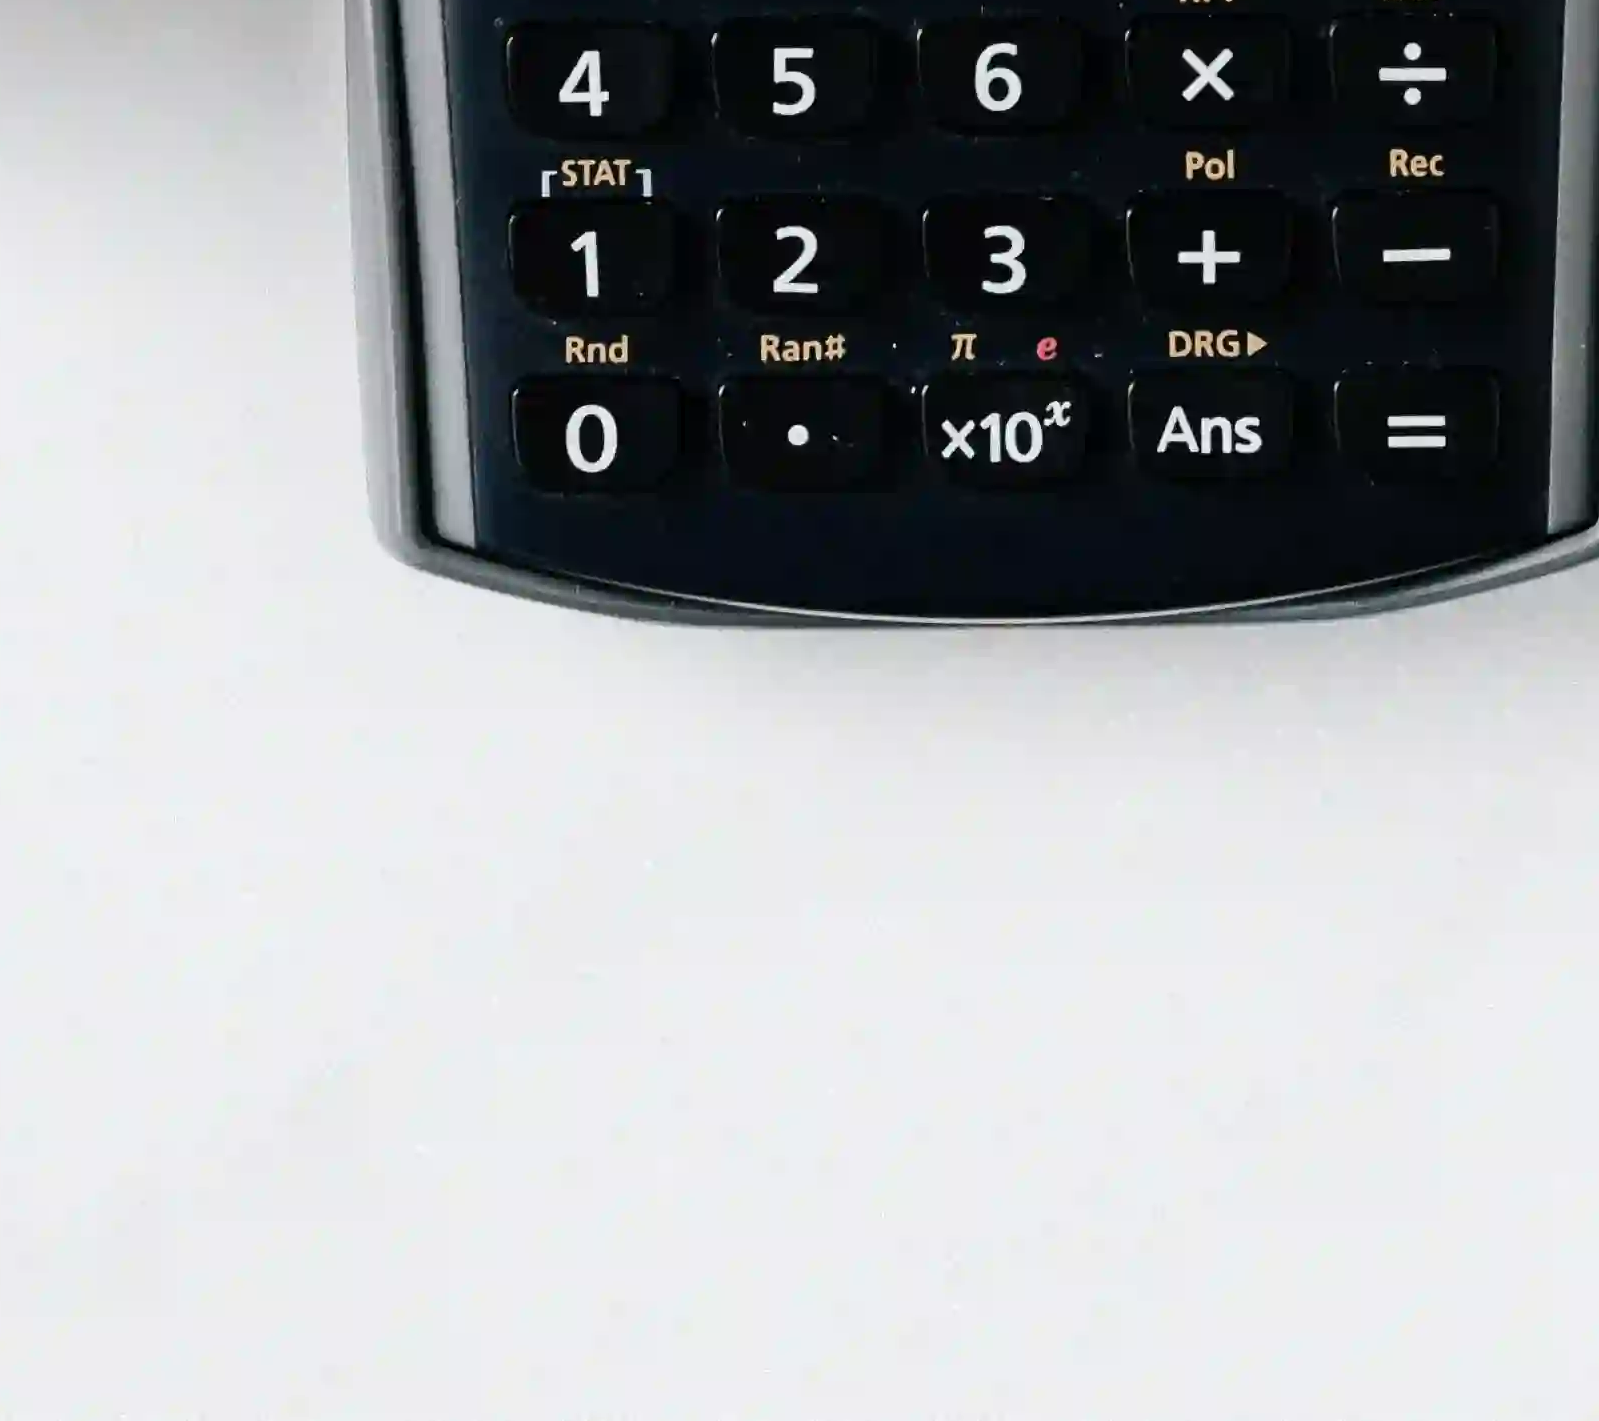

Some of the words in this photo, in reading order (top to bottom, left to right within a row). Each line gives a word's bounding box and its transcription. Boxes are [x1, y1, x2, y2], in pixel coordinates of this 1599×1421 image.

[559, 51, 609, 116] 4
[773, 48, 815, 115] 5
[975, 43, 1021, 111] 6
[562, 160, 631, 186] STAT
[1186, 150, 1234, 180] Pol
[1390, 149, 1444, 177] Rec
[571, 231, 598, 297] 1
[773, 226, 818, 293] 2
[982, 226, 1026, 293] 3
[566, 335, 628, 363] Rnd
[761, 334, 845, 362] Ran#
[566, 405, 617, 473] 0
[1157, 406, 1262, 453] Ans
